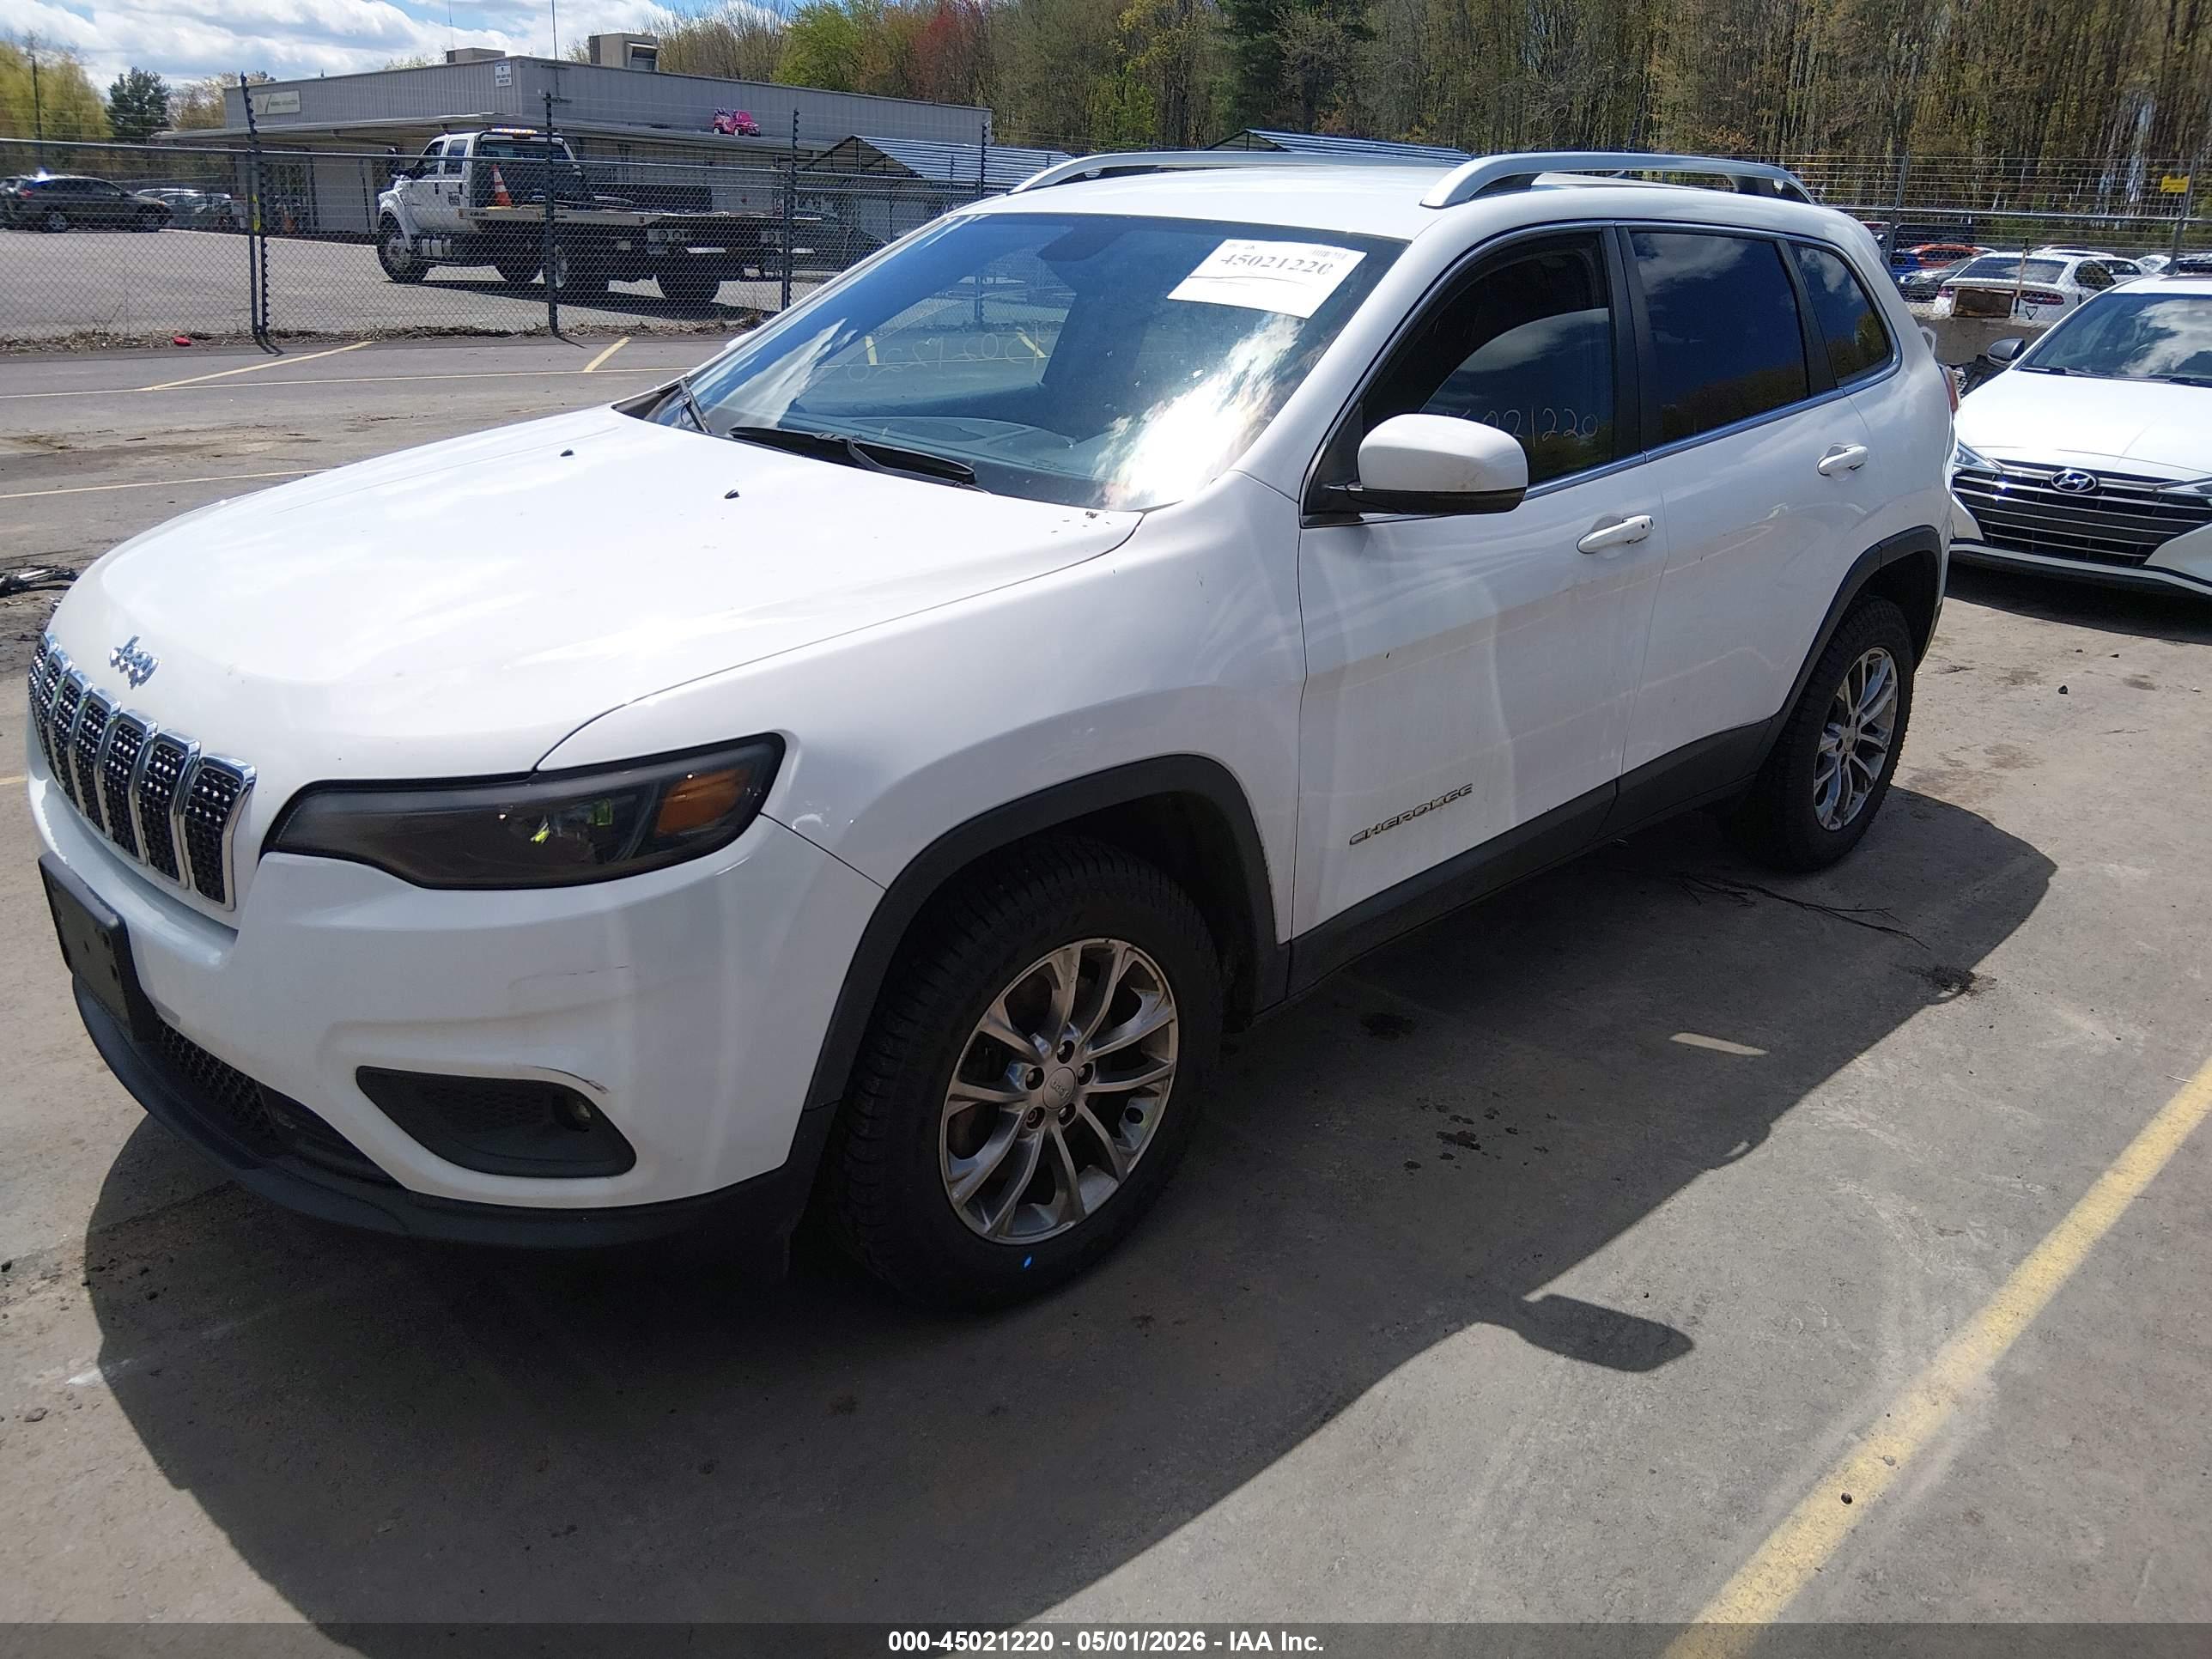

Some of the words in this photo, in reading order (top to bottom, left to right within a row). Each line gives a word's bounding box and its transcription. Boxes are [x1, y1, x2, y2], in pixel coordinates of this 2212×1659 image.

[1220, 253, 1334, 275] 45021220
[1446, 404, 1598, 447] 021220
[109, 635, 160, 690] Jeep
[1349, 783, 1473, 846] CHEROKEE
